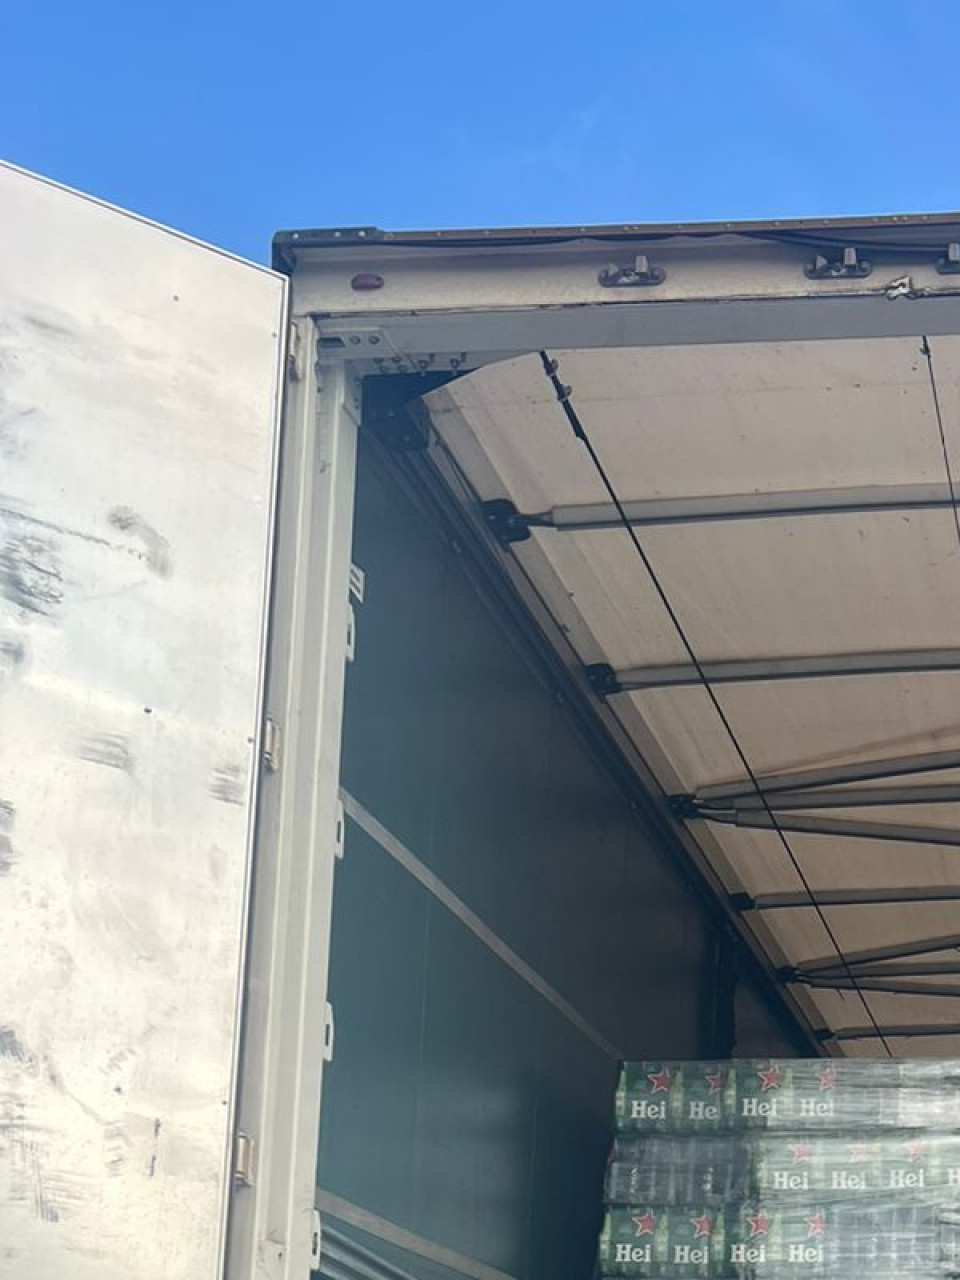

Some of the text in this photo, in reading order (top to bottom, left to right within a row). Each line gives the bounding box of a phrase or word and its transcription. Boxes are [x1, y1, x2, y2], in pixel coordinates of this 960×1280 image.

[631, 1100, 665, 1118] Hei
[742, 1099, 777, 1116] Hei
[800, 1099, 834, 1116] Hei
[774, 1171, 809, 1189] Hei
[890, 1169, 924, 1187] Hei
[616, 1245, 824, 1264] Hei Hei Hei Hei
